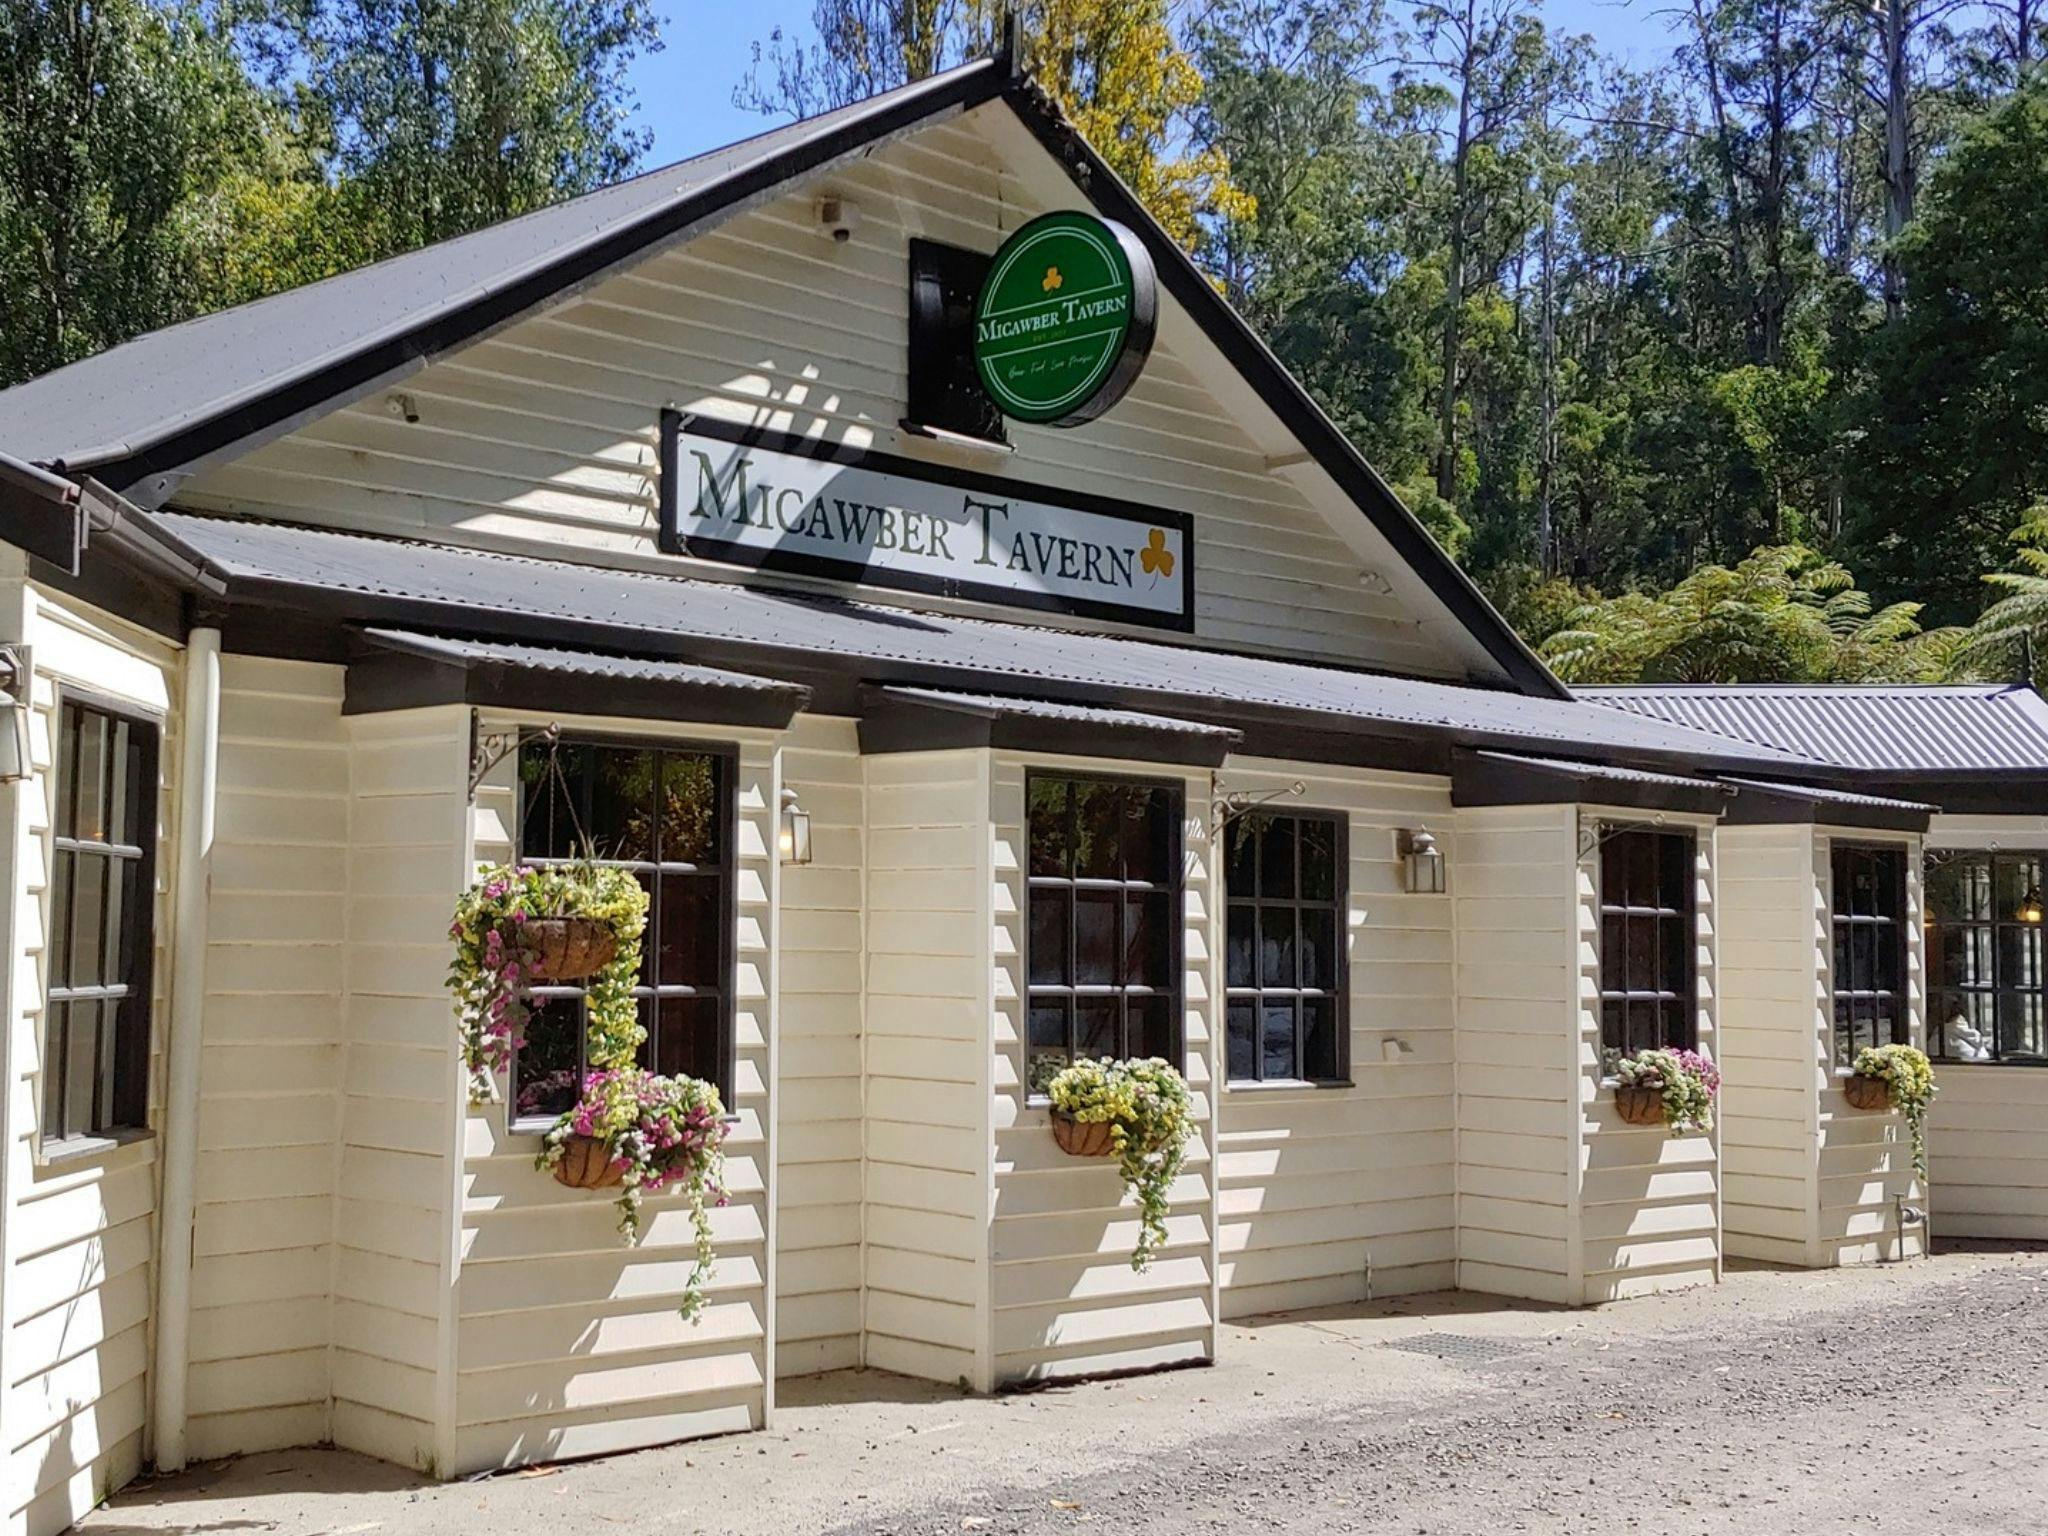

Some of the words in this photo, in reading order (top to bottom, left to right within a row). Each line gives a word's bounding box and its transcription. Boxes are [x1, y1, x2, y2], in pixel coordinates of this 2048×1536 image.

[978, 312, 1060, 342] MICAWBER
[1062, 295, 1127, 323] TAVERN
[689, 449, 955, 561] MICAWBER
[963, 495, 1135, 588] TAVERN
